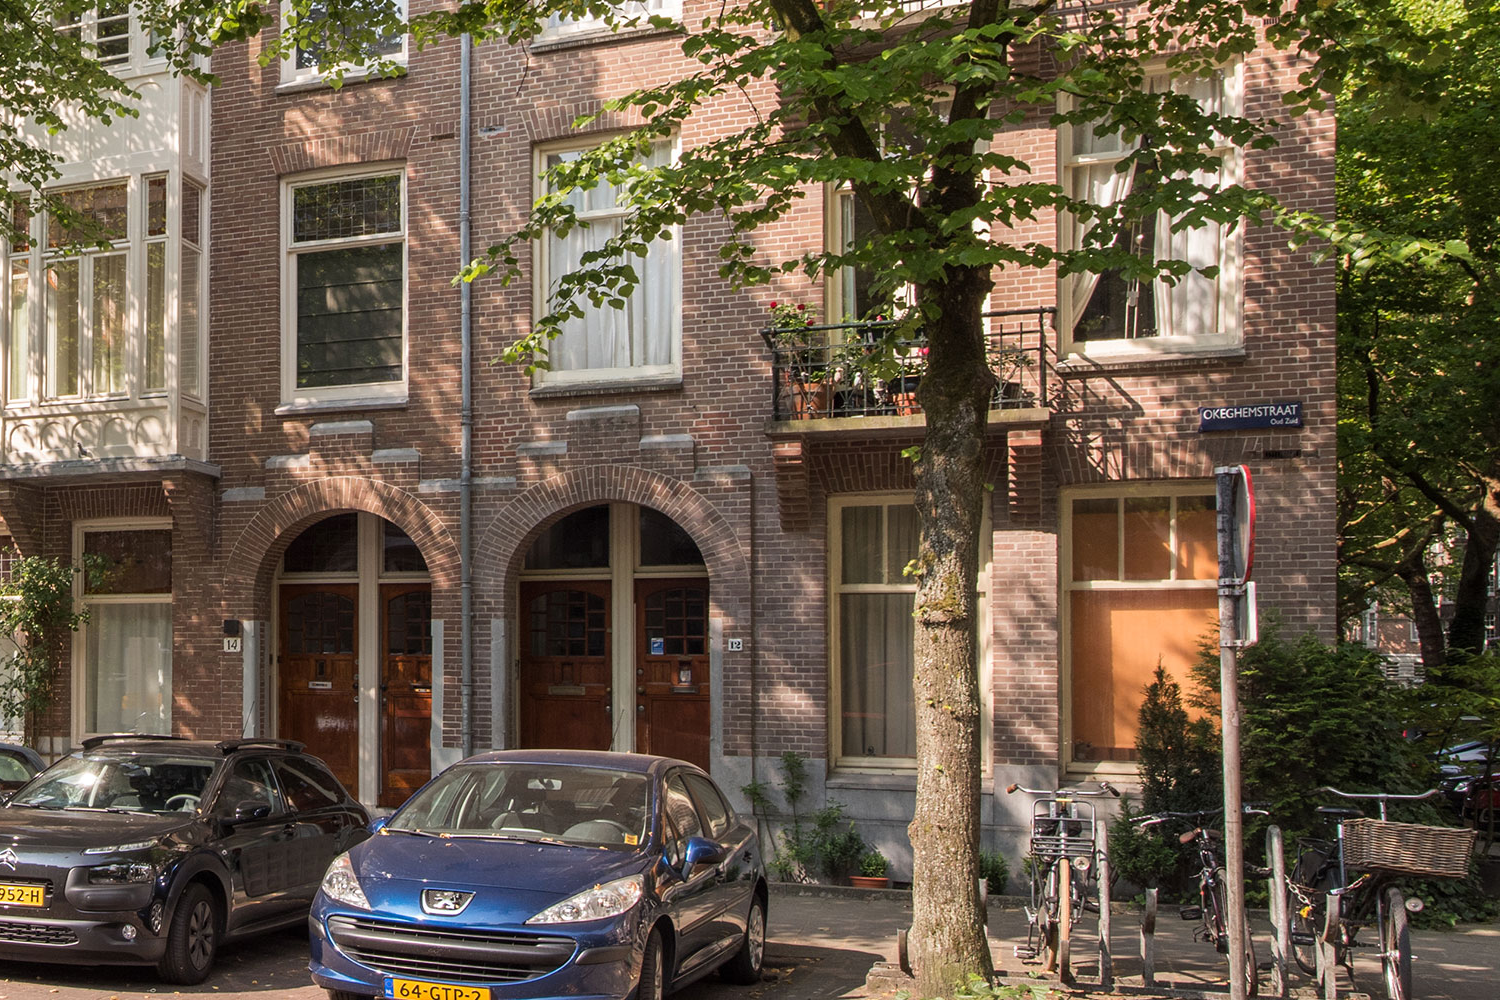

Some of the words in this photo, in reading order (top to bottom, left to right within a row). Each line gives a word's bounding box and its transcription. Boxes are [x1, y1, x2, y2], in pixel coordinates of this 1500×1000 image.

[1203, 404, 1298, 420] OKEGHEMSTRAAT
[1285, 417, 1298, 425] Zuid
[227, 640, 238, 650] 14
[730, 640, 741, 649] 12
[400, 983, 481, 1000] 64-GTP-2
